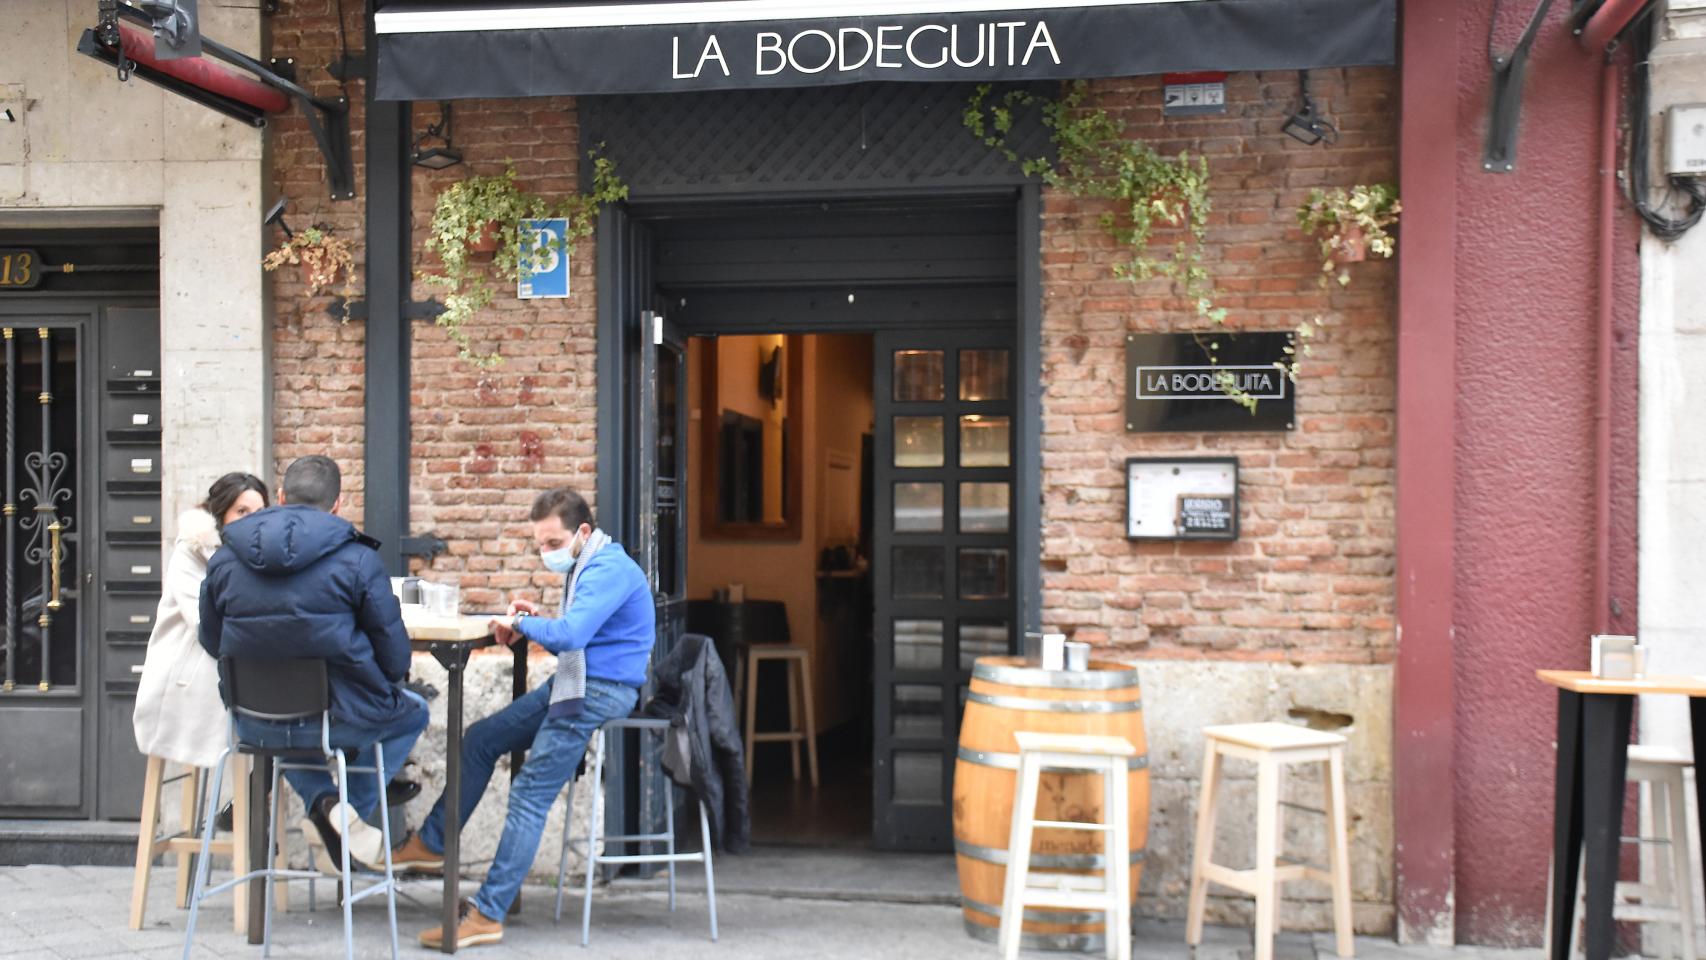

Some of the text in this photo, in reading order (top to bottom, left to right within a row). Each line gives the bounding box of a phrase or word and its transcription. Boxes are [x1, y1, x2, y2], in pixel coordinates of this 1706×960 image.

[672, 20, 1061, 79] LA BODEGUITA
[0, 253, 32, 285] 13
[1147, 373, 1273, 392] LA BODEUITA
